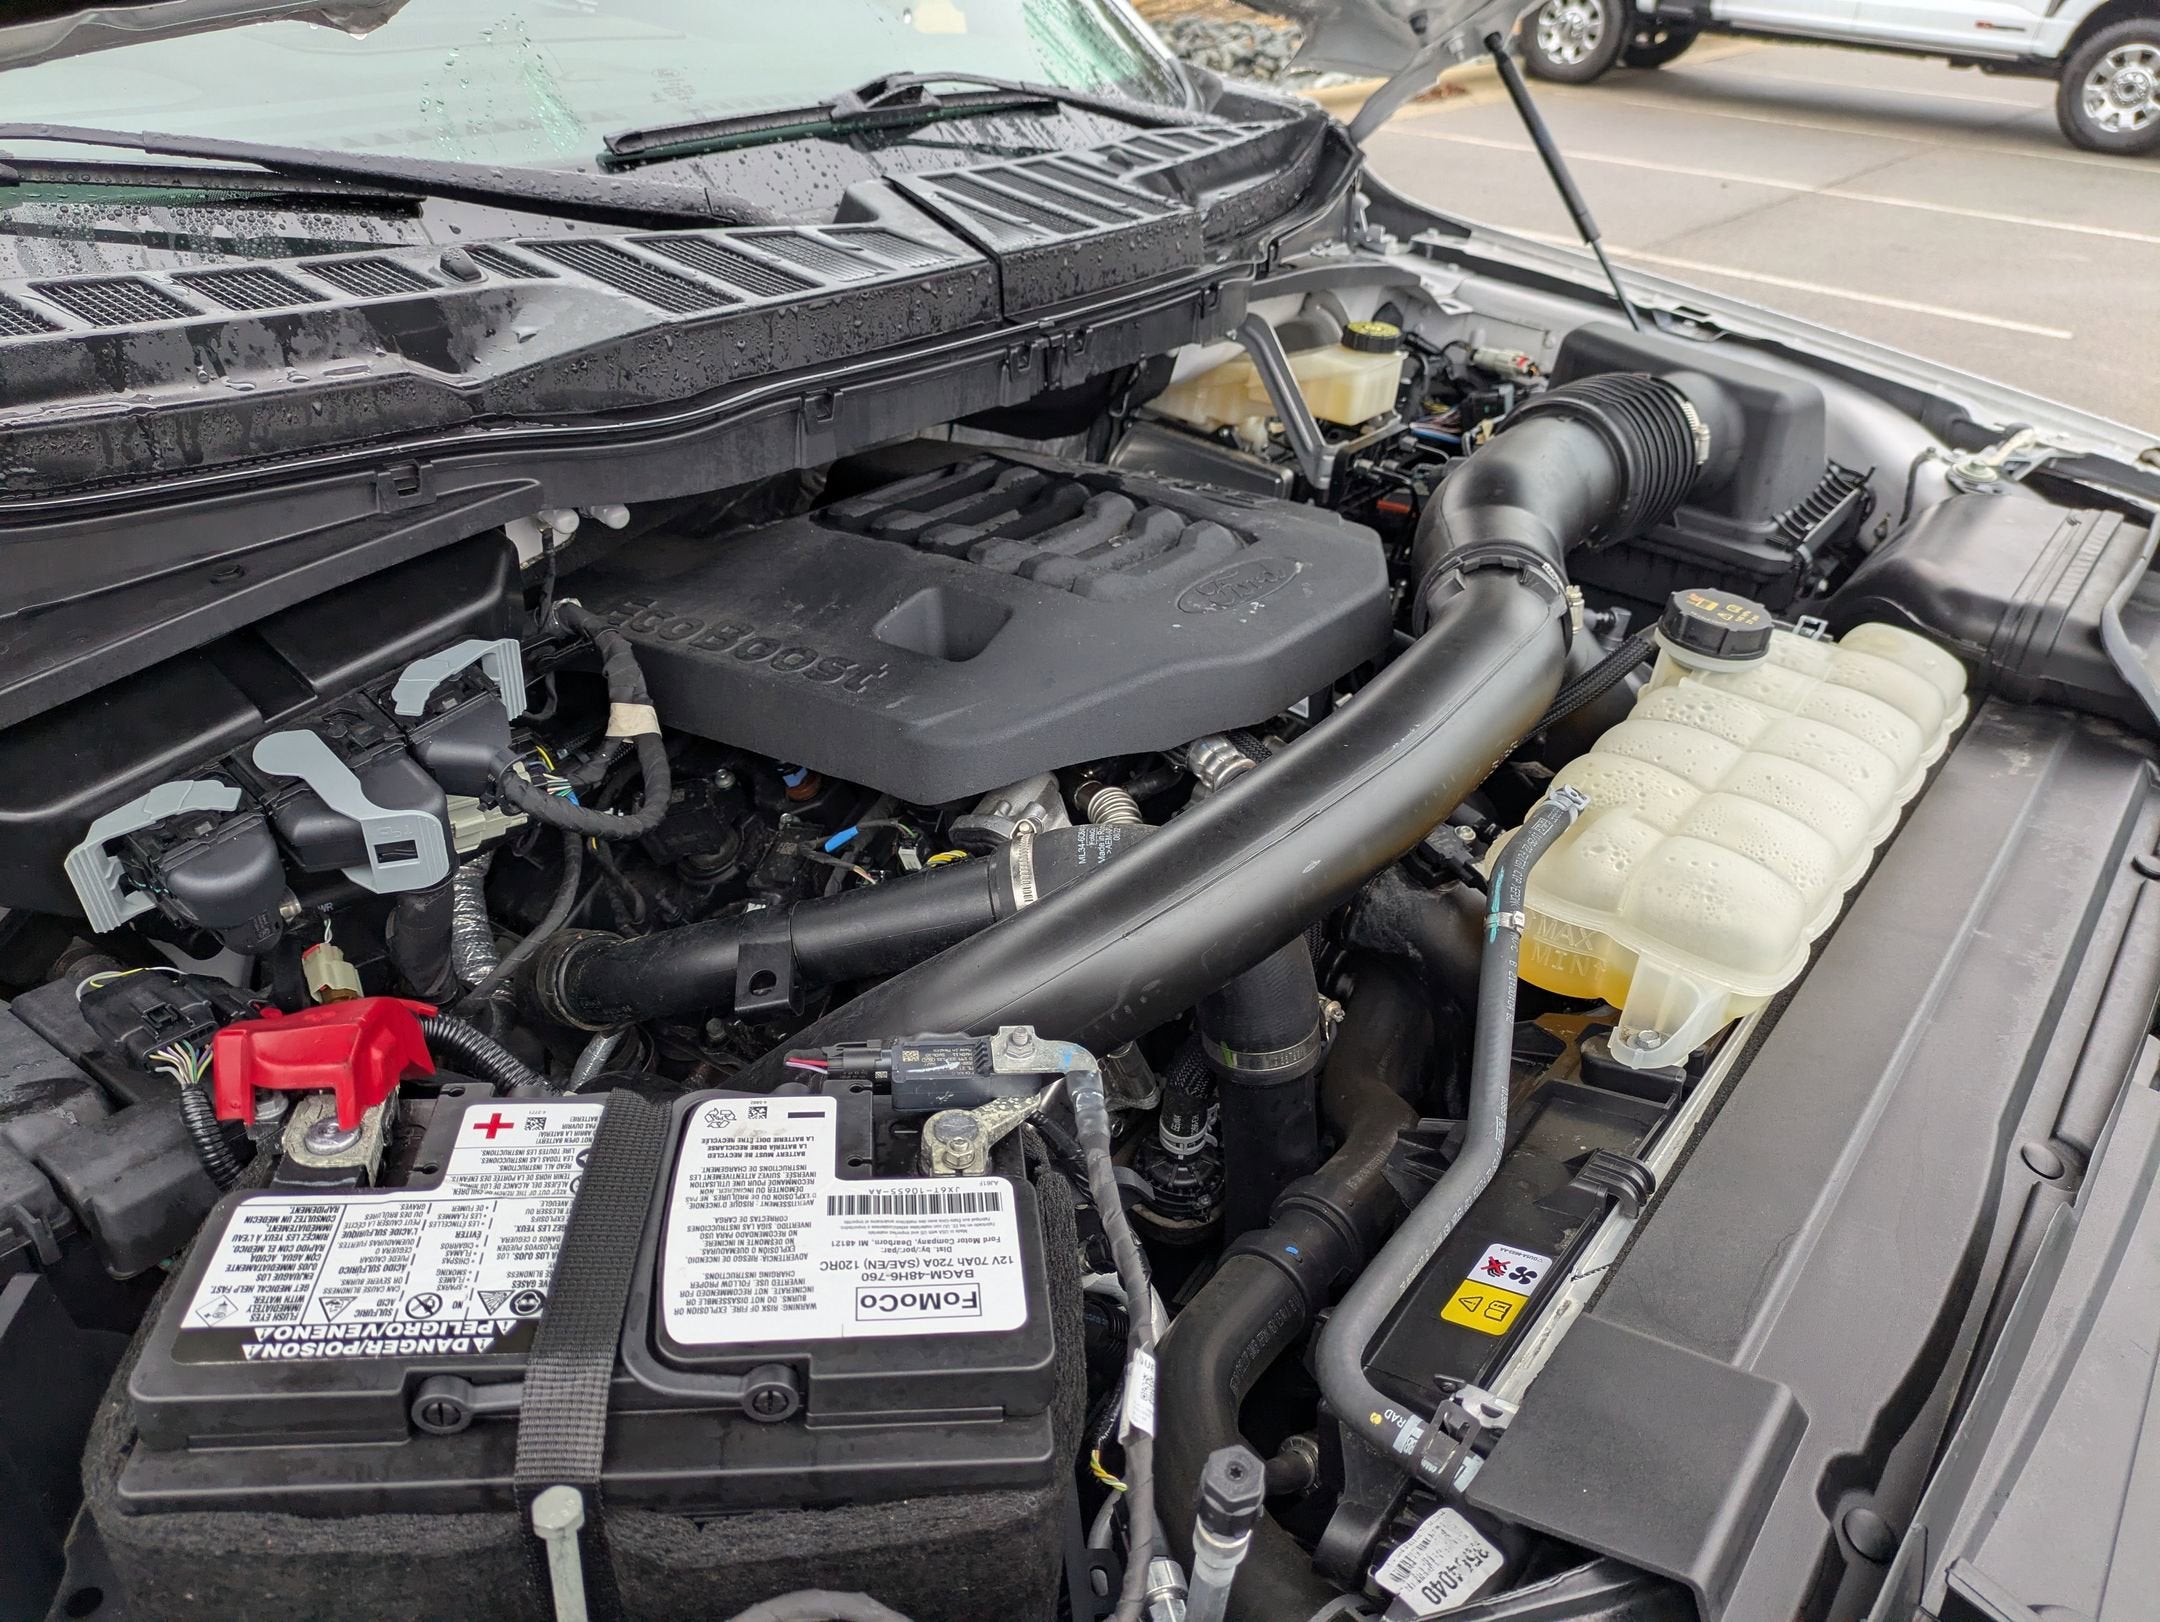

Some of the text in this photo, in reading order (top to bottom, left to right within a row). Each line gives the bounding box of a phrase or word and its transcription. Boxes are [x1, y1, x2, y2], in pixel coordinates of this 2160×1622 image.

[1536, 917, 1594, 951] MAX
[1531, 942, 1590, 977] MIN
[704, 1173, 757, 1181] ATTENTIVEMENT
[868, 1186, 960, 1195] JX6T-10655-AA
[245, 1215, 336, 1224] CONSULTEZ UN MÉDECIN
[687, 1224, 741, 1232] INSTRUCCIONES
[232, 1234, 256, 1242] L'EAU
[263, 1234, 285, 1242] YEUX
[285, 1234, 302, 1242] LES
[301, 1233, 330, 1242] RINCEZ
[735, 1230, 787, 1238] RECOMENDADO
[267, 1245, 278, 1253] EL
[277, 1244, 296, 1253] CON
[295, 1244, 326, 1253] RÁPIDO
[935, 1246, 952, 1254] Dist.
[733, 1254, 759, 1262] RIESGO
[761, 1253, 808, 1262] ADVERTENCIA:
[225, 1263, 318, 1272] OJOS INMEDIATAMENTE
[819, 1256, 1013, 1271] 12V 70Ah 720A (SAE/EN) 120RC
[256, 1272, 314, 1281] ENJUAGUE LOS
[703, 1270, 795, 1280] CHARGING INSTRUCTIONS.
[861, 1269, 973, 1282] BAGM-48H6-760
[341, 1277, 403, 1288] OR SEVERE BURNS.
[721, 1280, 751, 1288] FOLLOW
[771, 1278, 806, 1286] INVERTED
[210, 1284, 309, 1294] GET MEDICAL HELP FAST.
[320, 1286, 401, 1296] CAN CAUSE BLINDNESS
[696, 1288, 753, 1297] RECOMMENDED
[253, 1295, 305, 1304] WITH WATER.
[377, 1298, 396, 1307] ACID
[699, 1297, 750, 1306] DISASSEMBLE
[781, 1294, 807, 1303] BURNS.
[860, 1291, 977, 1312] FoMoCo
[247, 1304, 302, 1313] IMMEDIATELY
[452, 1301, 464, 1309] NO
[780, 1303, 817, 1311] WARNING:
[354, 1308, 393, 1318] SULFURIC
[686, 1306, 728, 1315] EXPLOSION
[250, 1313, 299, 1322] FLUSH EYES
[273, 1320, 495, 1341] PELIGRO/VENENO
[260, 1338, 470, 1358] DANGER/POISON
[1384, 1408, 1407, 1429] RAD
[1421, 1541, 1490, 1606] 354040
